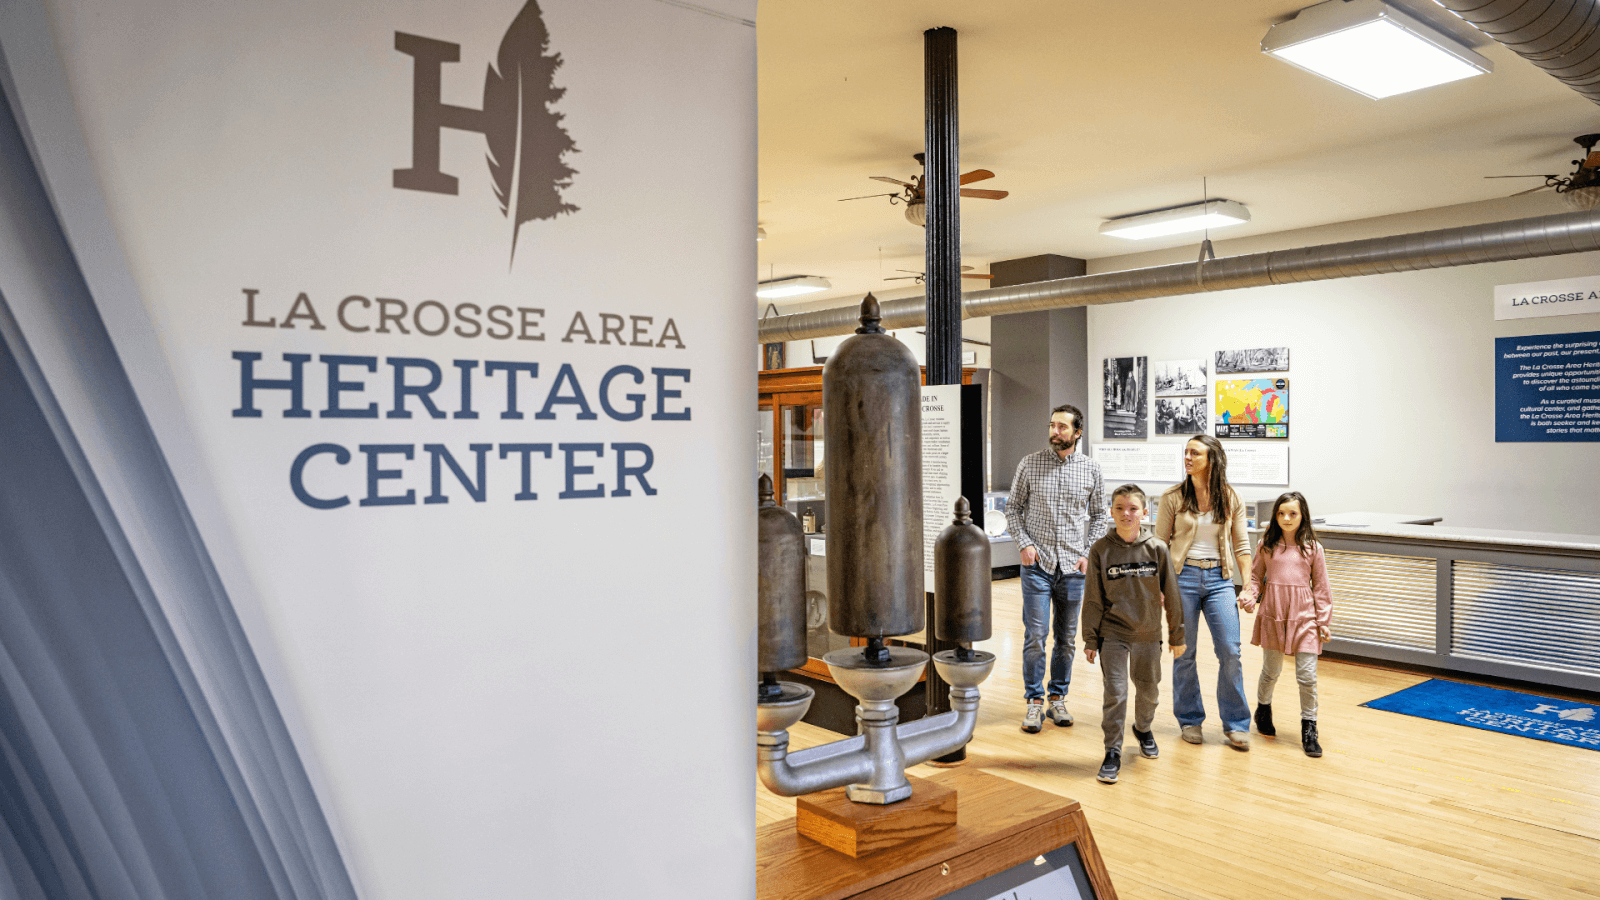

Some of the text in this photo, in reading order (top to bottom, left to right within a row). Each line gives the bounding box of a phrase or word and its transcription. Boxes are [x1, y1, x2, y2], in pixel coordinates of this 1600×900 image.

[1512, 291, 1600, 306] LA CROSSE A
[242, 288, 686, 349] LA CROSSE AREA
[1512, 372, 1540, 380] provides
[232, 350, 692, 422] HERITAGE
[1538, 384, 1547, 392] of
[289, 441, 657, 511] CENTER
[1108, 566, 1156, 574] Champion
